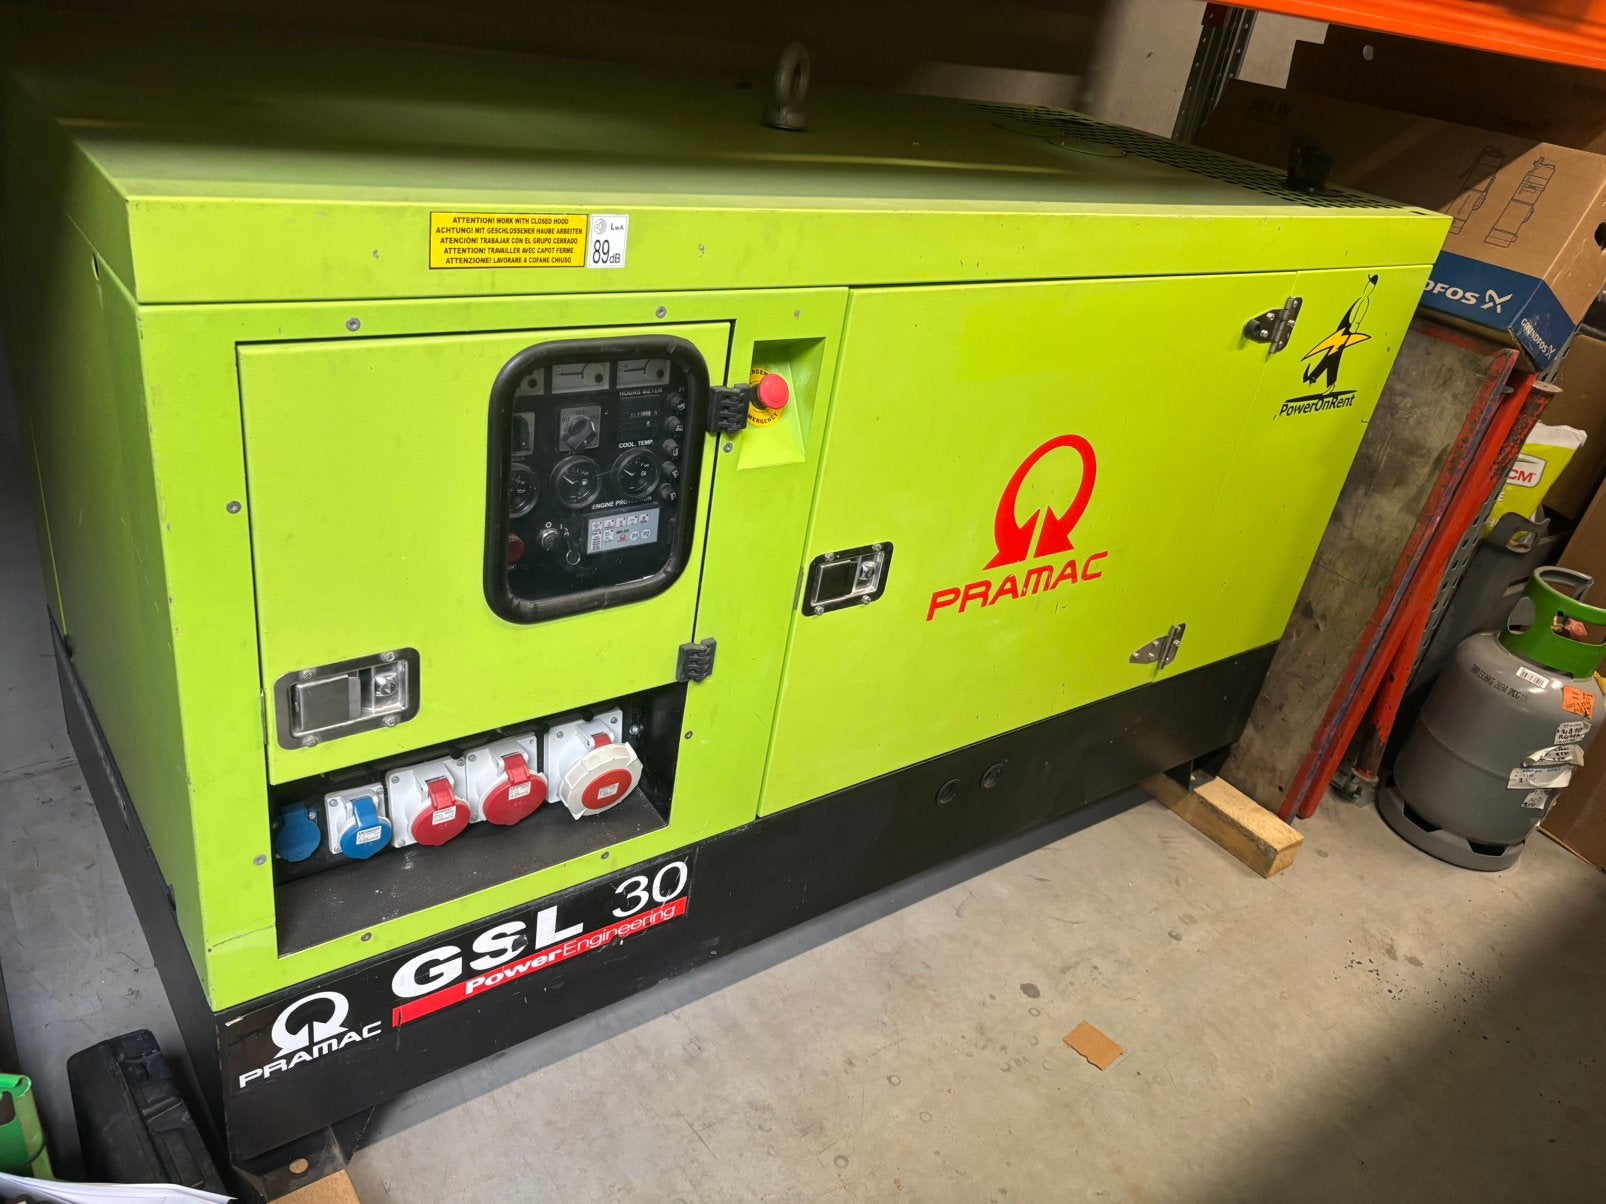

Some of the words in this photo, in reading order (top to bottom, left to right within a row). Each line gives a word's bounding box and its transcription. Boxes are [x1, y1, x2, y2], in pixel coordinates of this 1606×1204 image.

[435, 226, 474, 234] ACHTUNG!
[486, 227, 536, 235] GESCHLOSSENER
[536, 227, 556, 235] HAUBE
[556, 227, 583, 235] ARBEITEN
[453, 216, 495, 225] ATTENTION!
[496, 217, 514, 225] WORK
[515, 217, 530, 225] WITH
[511, 237, 524, 245] CON
[532, 237, 552, 245] GRUPO
[552, 237, 578, 245] CERRADO
[1520, 317, 1549, 354] GRUNDFOS
[1279, 393, 1356, 417] PowerOnRent
[592, 501, 615, 510] ENGINE
[925, 550, 1109, 622] PRAMAC
[391, 905, 585, 999] GSL
[612, 860, 688, 919] 30
[238, 1019, 382, 1089] PRAMAC
